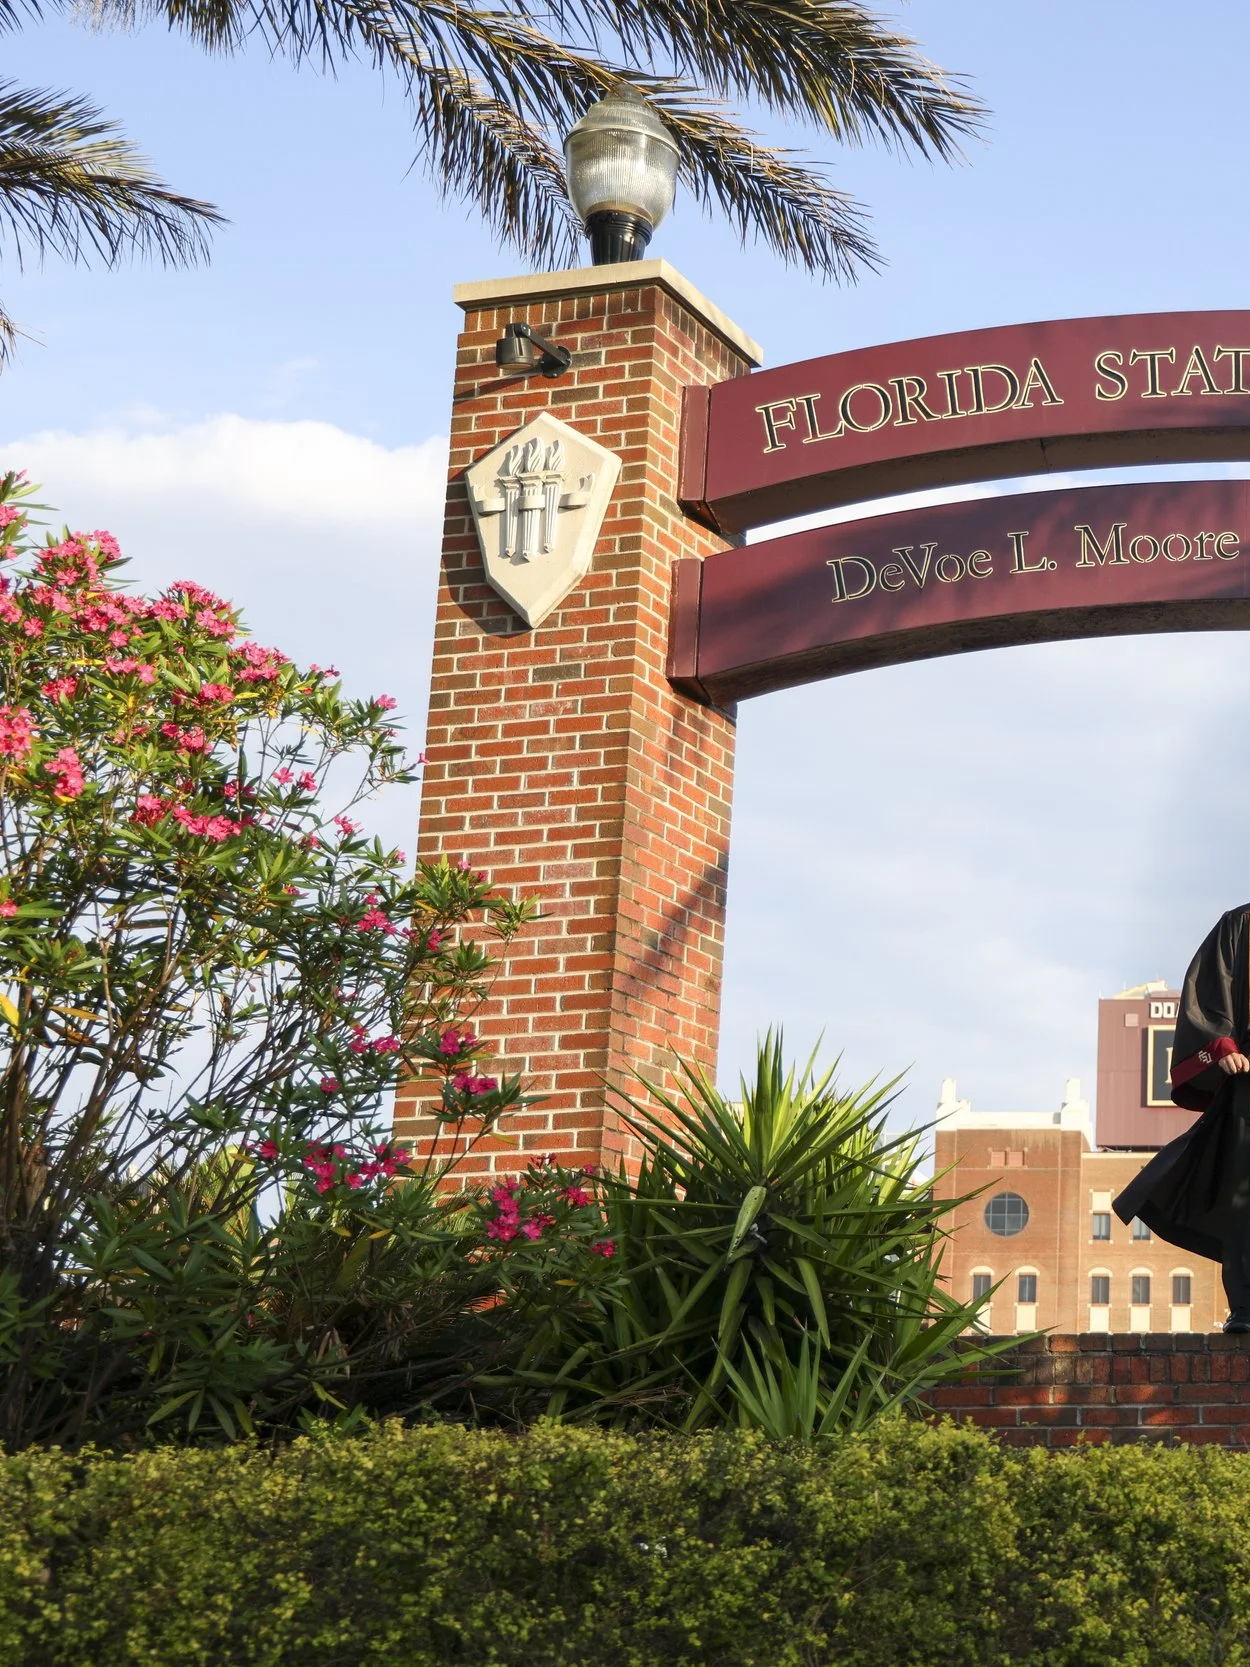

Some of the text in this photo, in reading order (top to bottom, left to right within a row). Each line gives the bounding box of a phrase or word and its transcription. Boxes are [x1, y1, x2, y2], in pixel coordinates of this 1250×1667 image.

[755, 357, 1064, 454] FLORIDA
[826, 542, 993, 603] DeVoe
[1008, 531, 1059, 575] L.
[1074, 522, 1240, 568] Moore
[1150, 1002, 1179, 1018] DO
